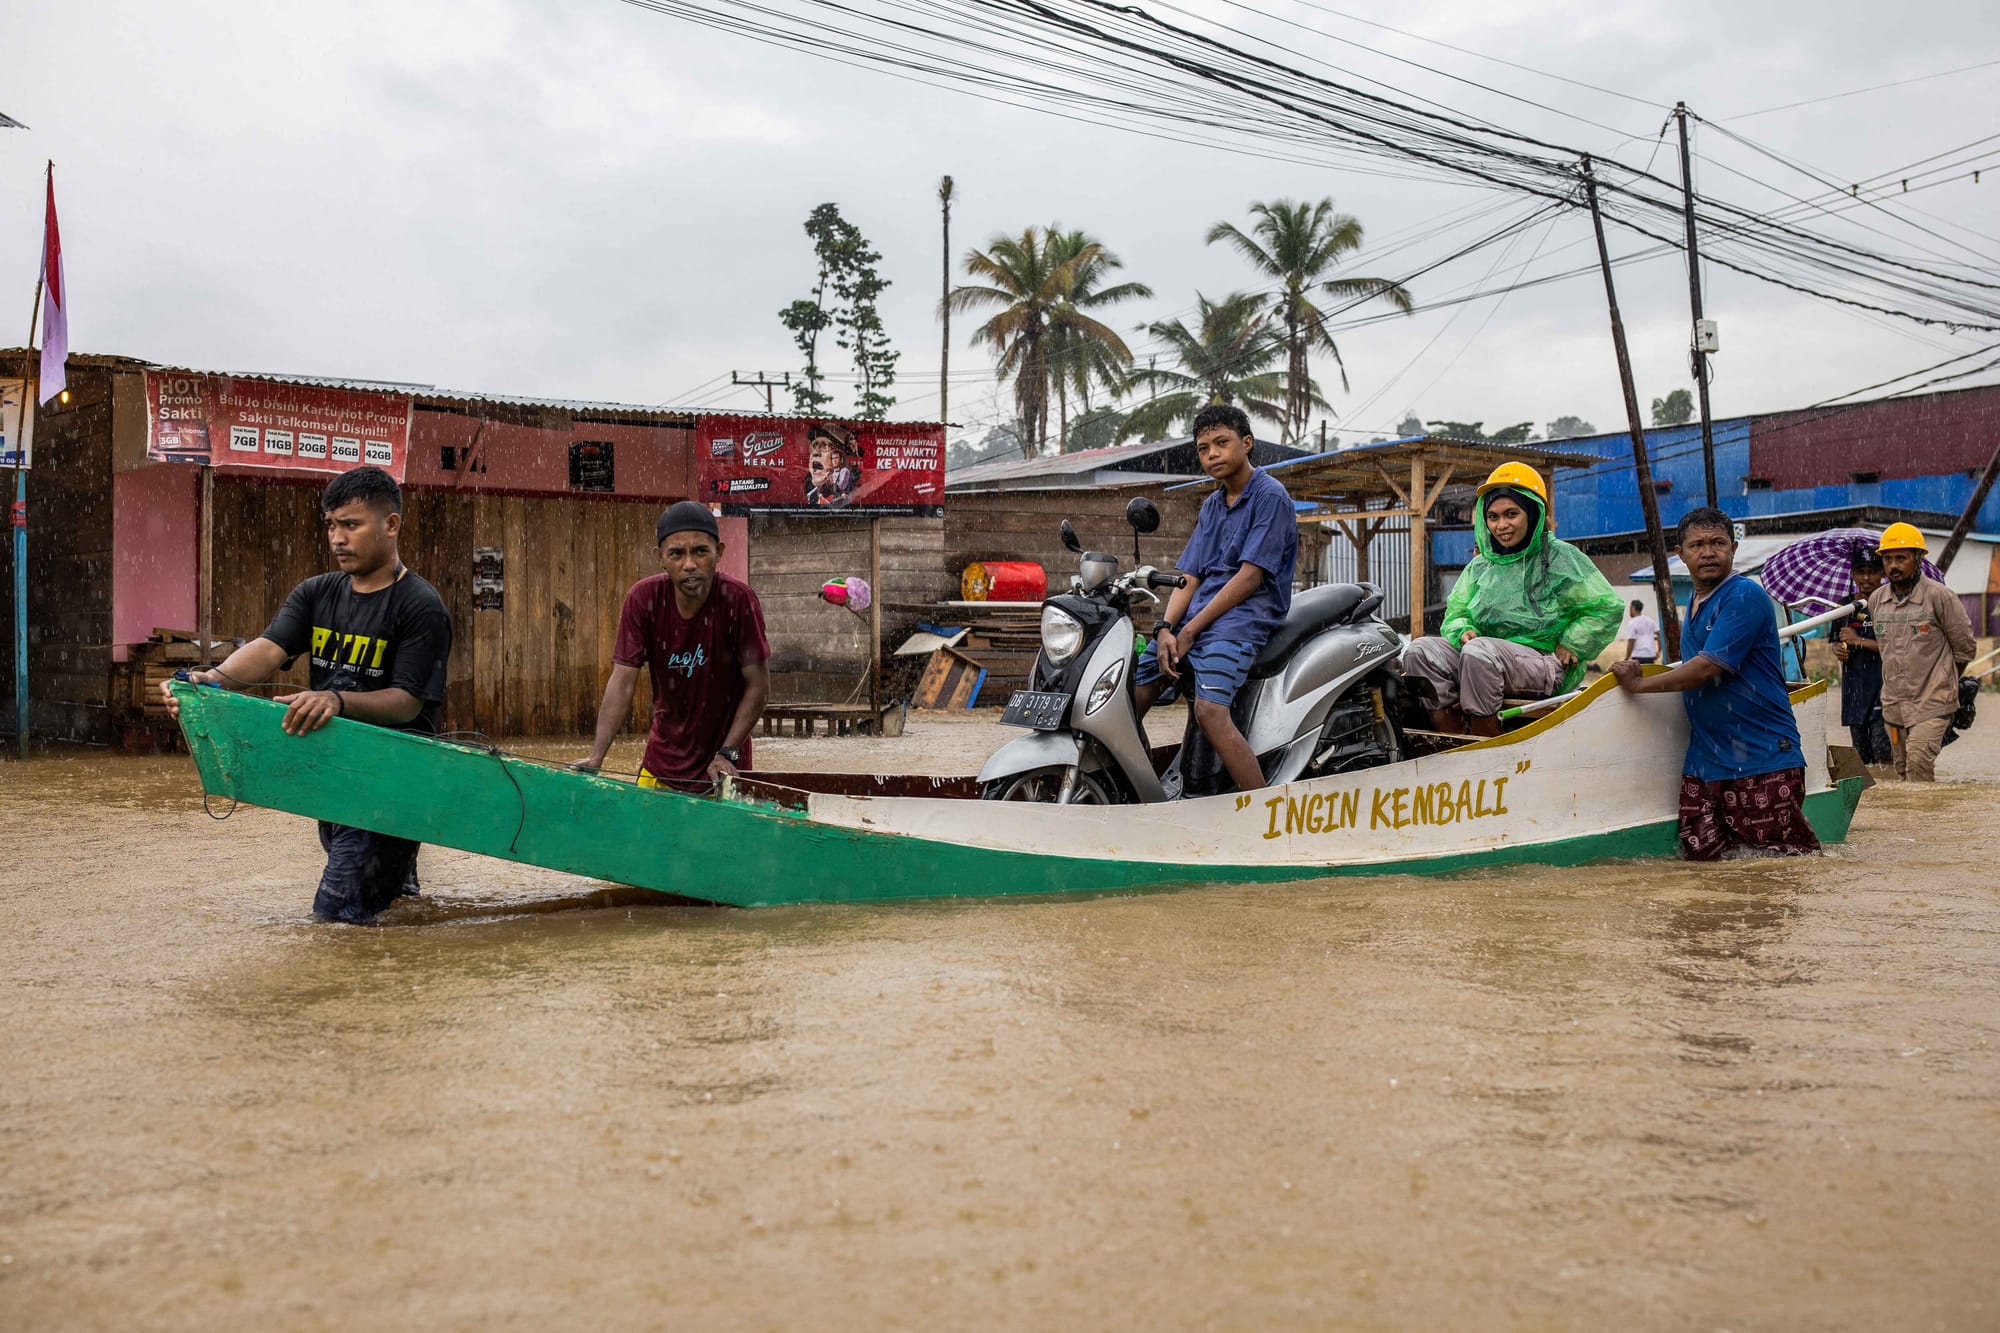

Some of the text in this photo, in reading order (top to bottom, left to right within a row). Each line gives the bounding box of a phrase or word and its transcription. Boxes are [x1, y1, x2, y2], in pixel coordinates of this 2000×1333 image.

[160, 379, 203, 394] HOT
[160, 395, 202, 405] Promo
[160, 407, 202, 420] Sakti
[219, 394, 406, 425] Beli Jo Disini Kartu Hot Promo
[239, 412, 388, 438] Sakti Telkomsel Disini!!!
[160, 437, 179, 445] 3GB
[234, 436, 257, 447] 7GB
[266, 439, 292, 451] 11GB
[743, 432, 784, 457] Garam
[299, 442, 326, 454] 20GB
[332, 446, 359, 457] 26GB
[876, 448, 938, 458] DARI WAKTU
[366, 450, 391, 461] 42GB
[744, 458, 784, 466] MERAH
[876, 458, 938, 470] KE WAKTU
[717, 480, 729, 492] 16
[1009, 694, 1067, 711] DB 3179 CX
[1262, 788, 1360, 840] INGIN
[1370, 776, 1509, 830] KEMBALI
